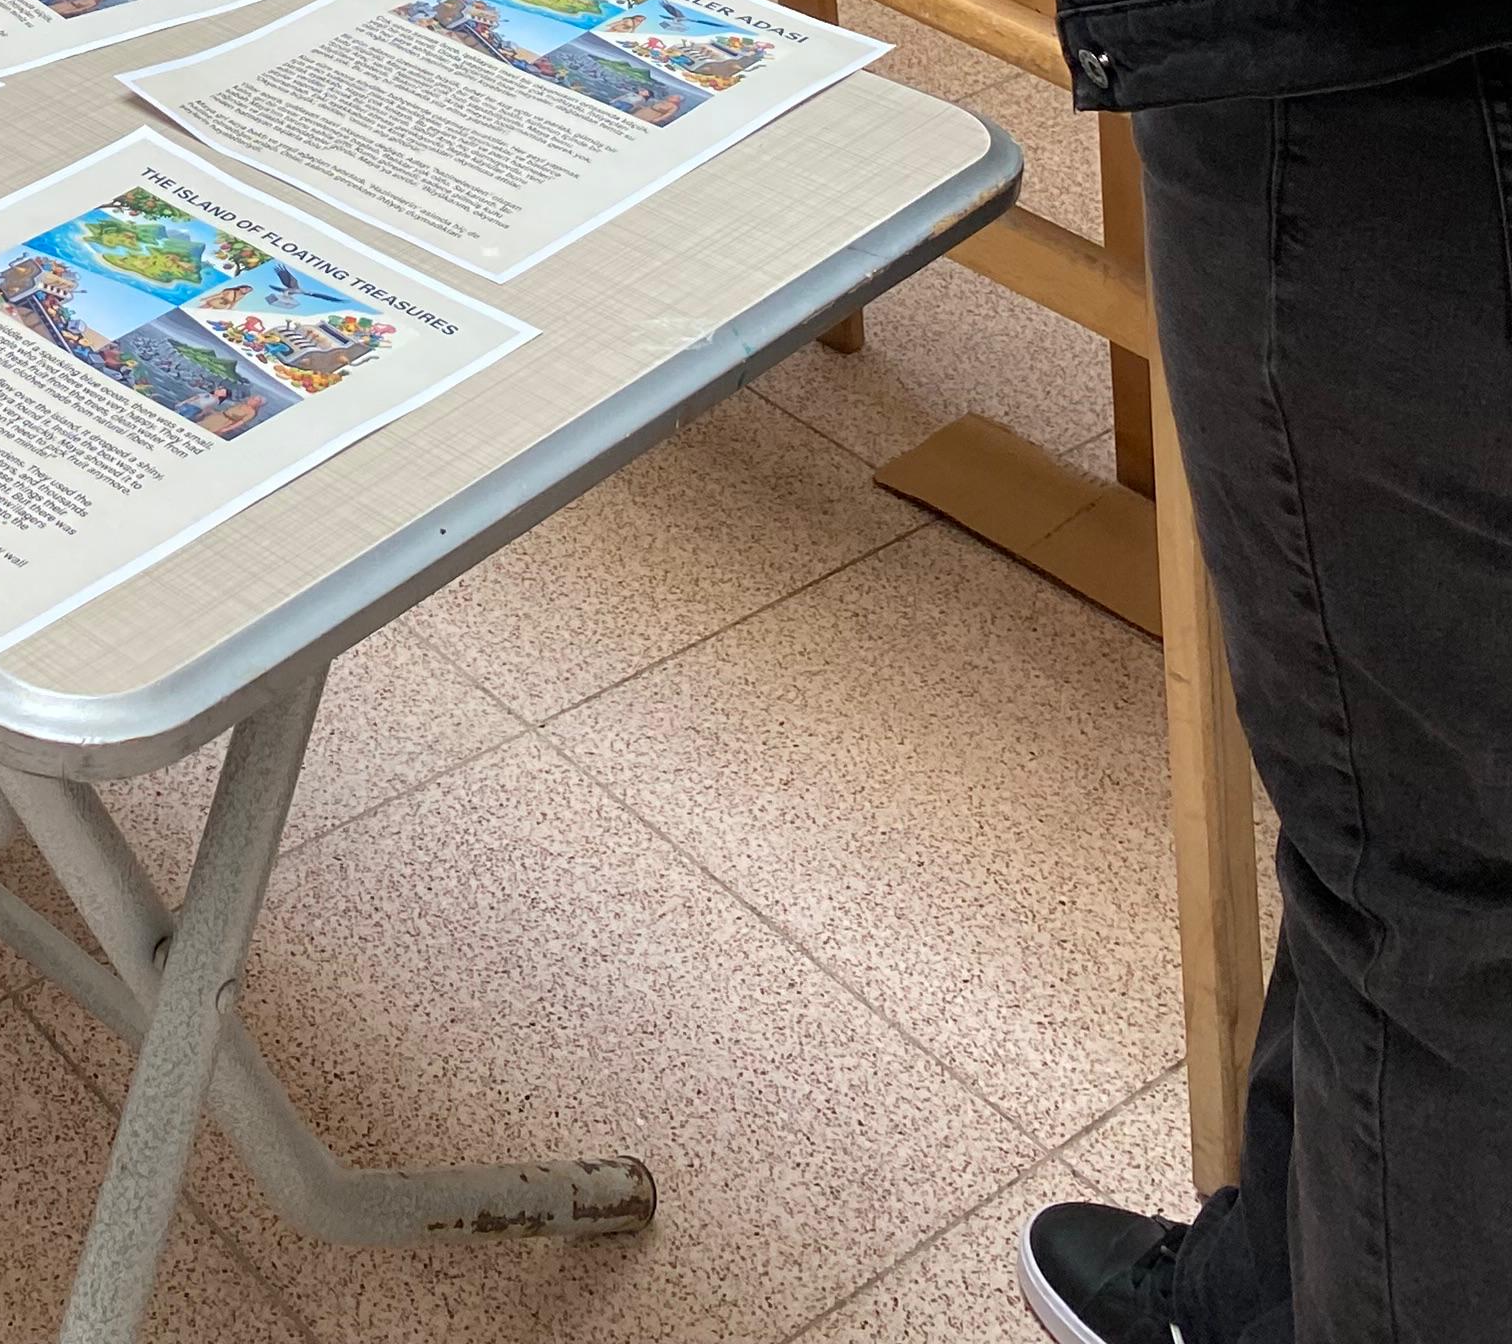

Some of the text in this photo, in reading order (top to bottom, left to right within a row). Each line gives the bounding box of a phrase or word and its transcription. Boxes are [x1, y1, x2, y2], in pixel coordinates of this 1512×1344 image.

[736, 16, 808, 43] ADASI
[141, 167, 458, 335] THE ISLAND OF FLOATING TREASURES
[17, 347, 37, 361] who
[36, 358, 61, 375] lived
[58, 372, 83, 389] there
[82, 387, 106, 402] were
[105, 400, 127, 414] very
[156, 427, 183, 445] They
[182, 440, 204, 455] had
[3, 552, 29, 568] wall
